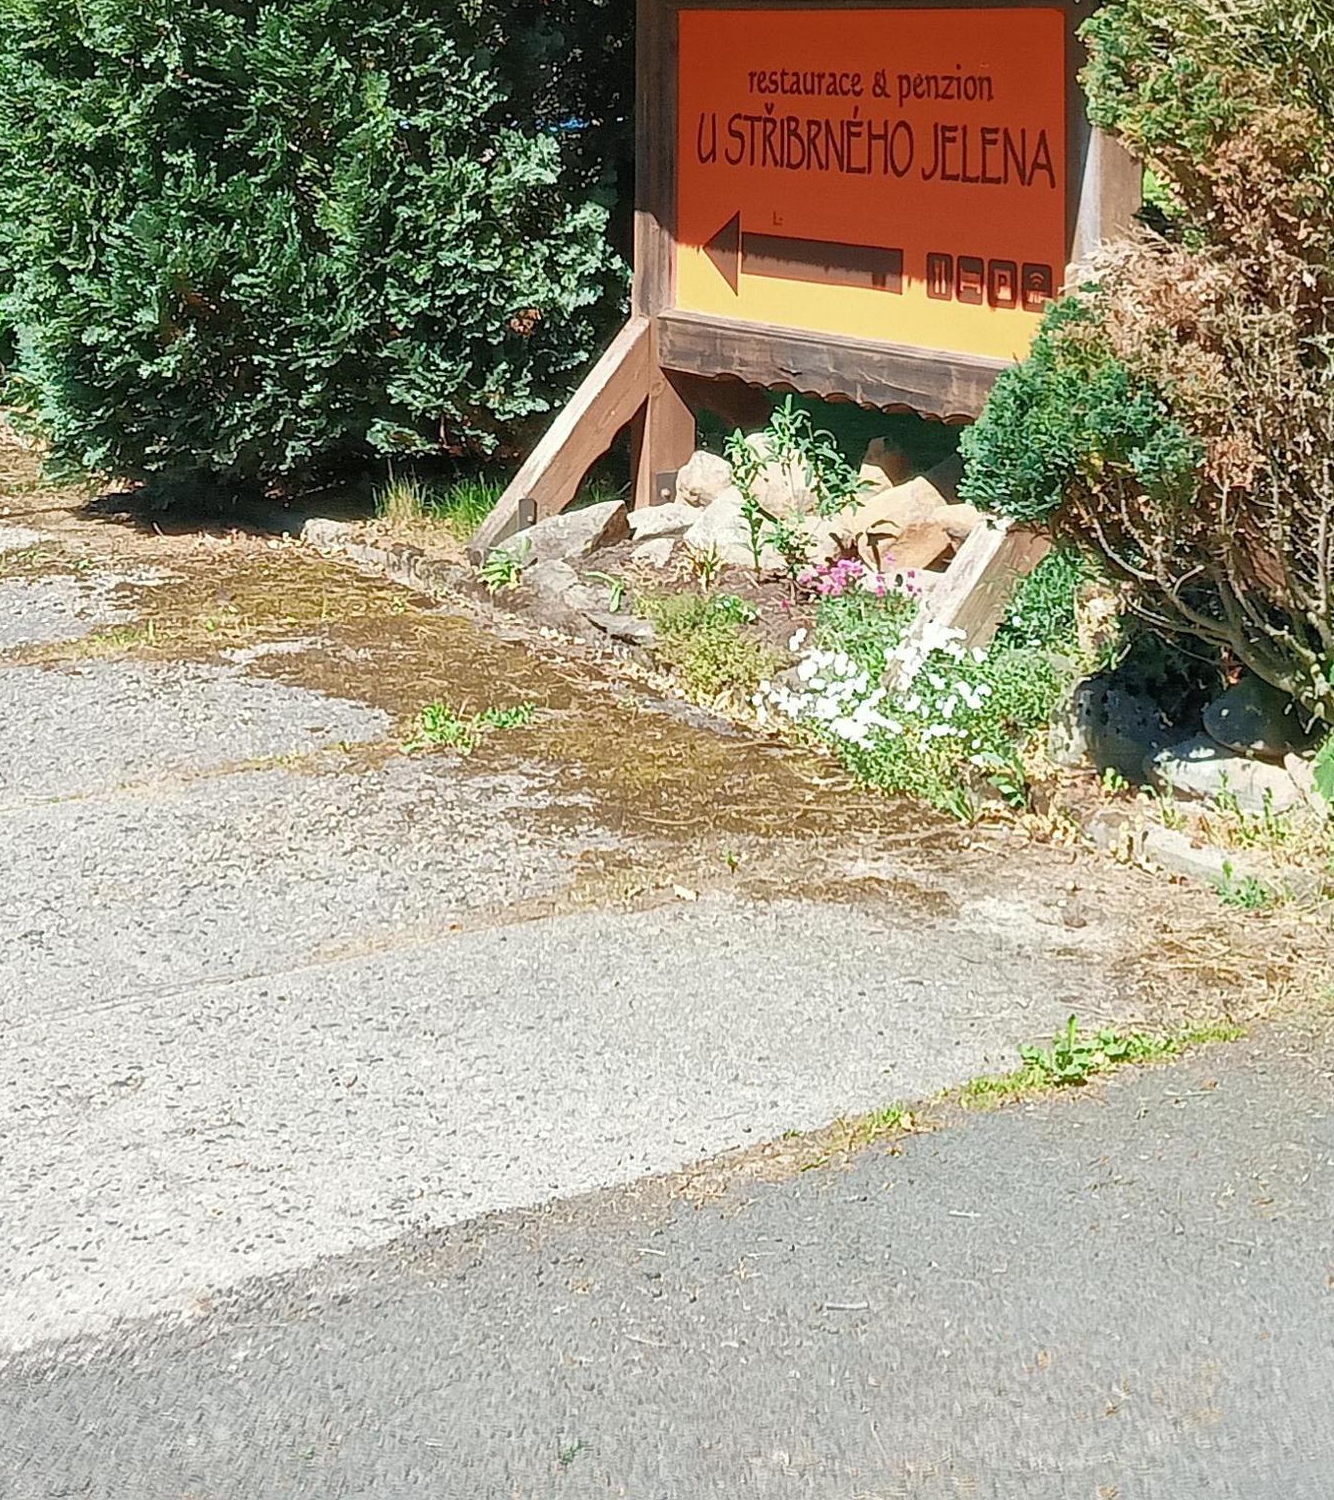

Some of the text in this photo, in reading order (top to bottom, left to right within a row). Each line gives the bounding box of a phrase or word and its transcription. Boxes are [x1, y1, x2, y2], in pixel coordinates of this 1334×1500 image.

[747, 63, 994, 107] restaurace & penzion
[696, 111, 718, 164] U
[921, 120, 1057, 189] JELENA
